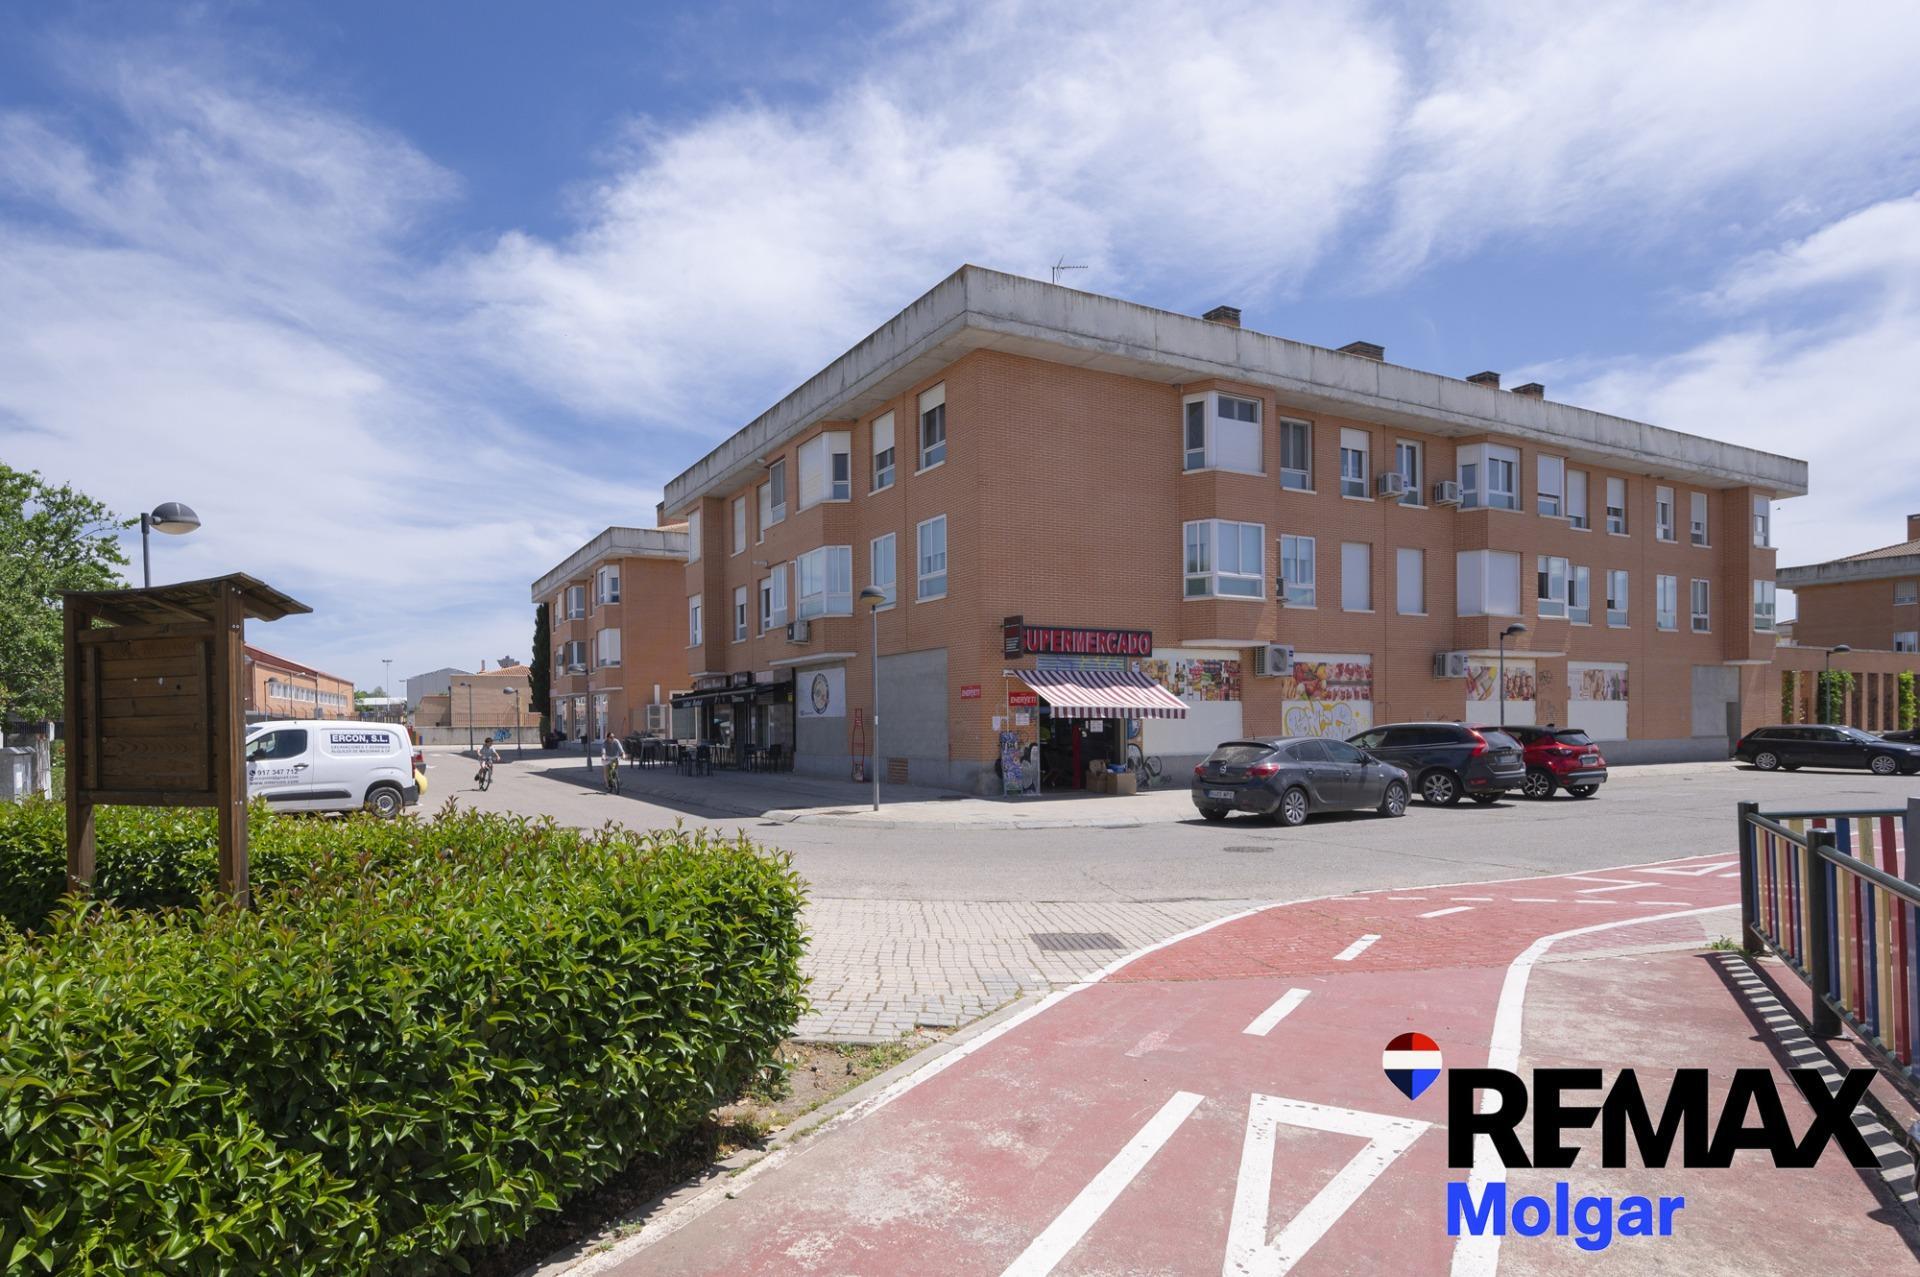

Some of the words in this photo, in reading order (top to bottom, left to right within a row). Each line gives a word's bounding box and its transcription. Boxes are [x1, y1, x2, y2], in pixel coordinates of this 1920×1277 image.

[1024, 628, 1151, 655] UPERMERCADO
[332, 734, 369, 743] ERCON,
[371, 734, 388, 742] S.L.
